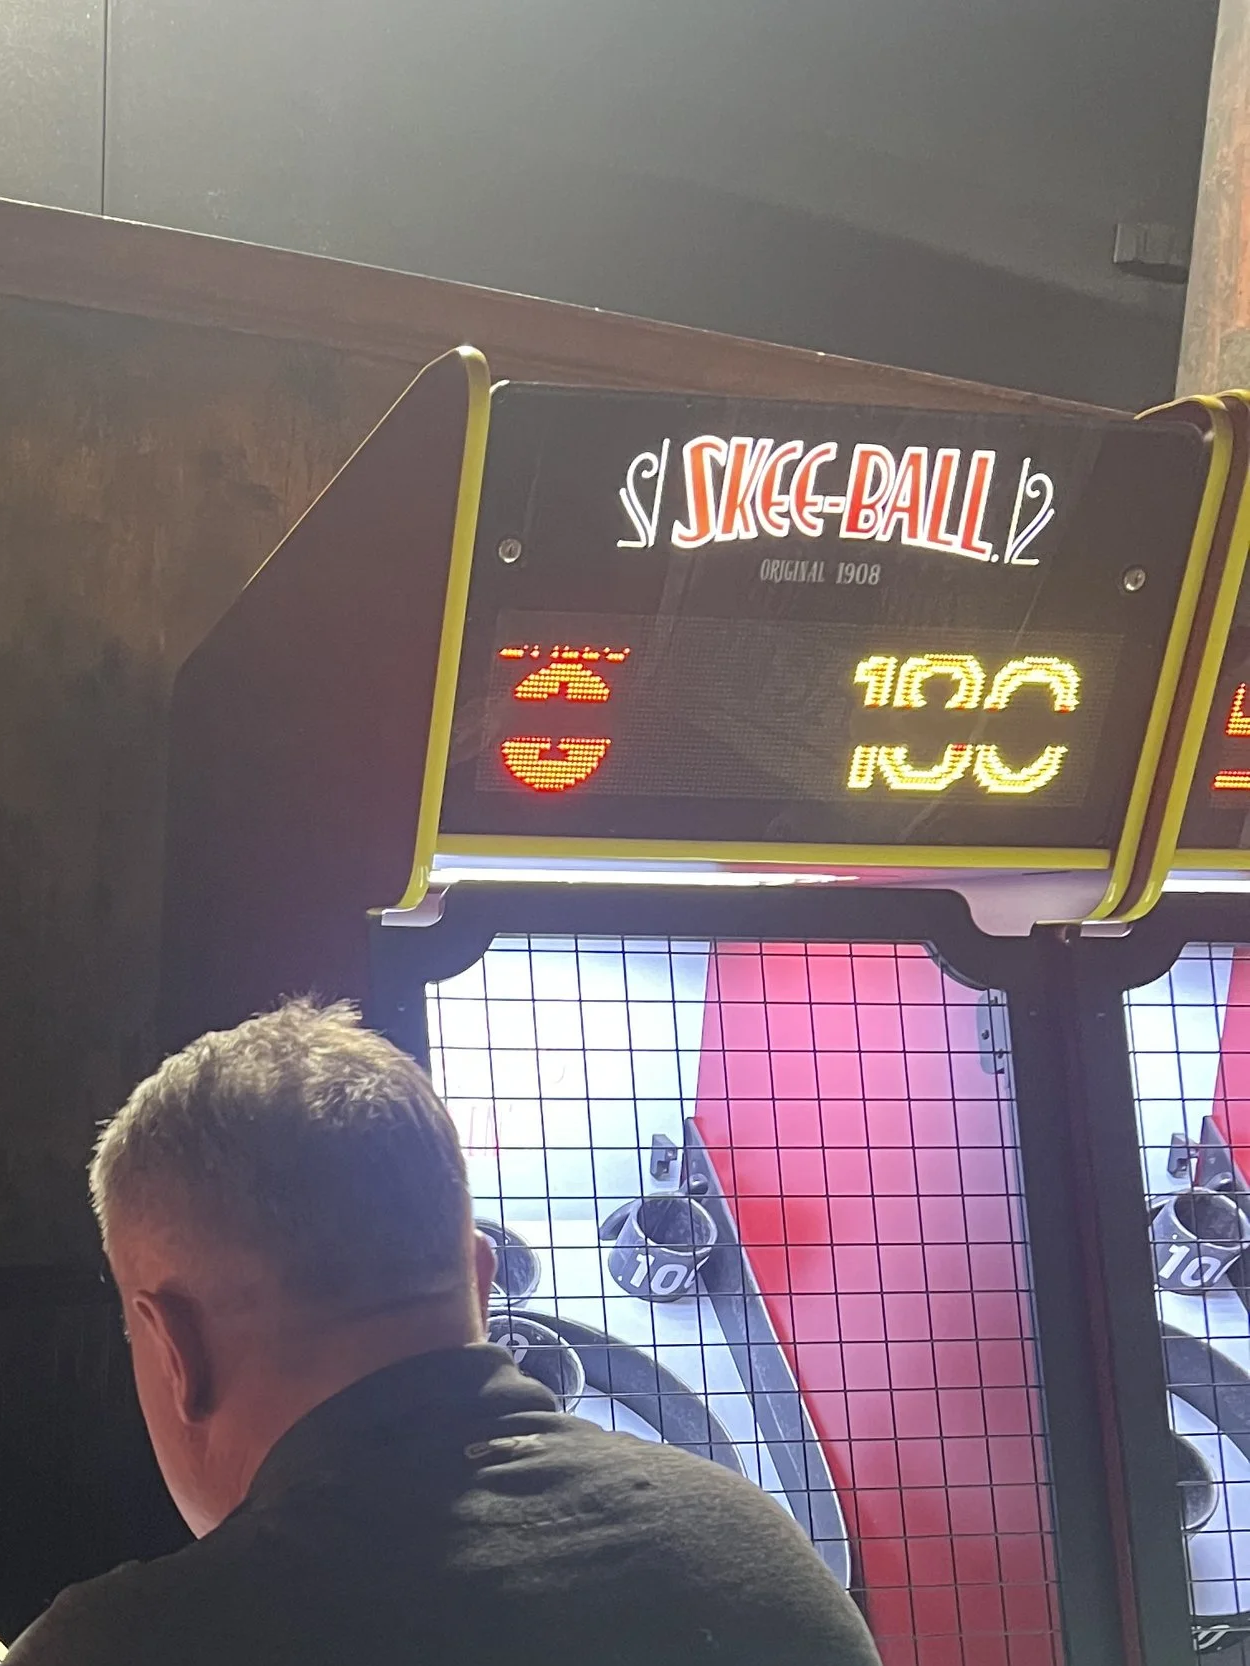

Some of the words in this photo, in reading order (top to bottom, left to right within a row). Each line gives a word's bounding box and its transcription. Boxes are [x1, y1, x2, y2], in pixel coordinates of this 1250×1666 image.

[759, 558, 826, 584] ORIGINAL
[835, 561, 882, 586] 1908
[630, 1253, 710, 1296] 10
[1158, 1243, 1242, 1288] 10
